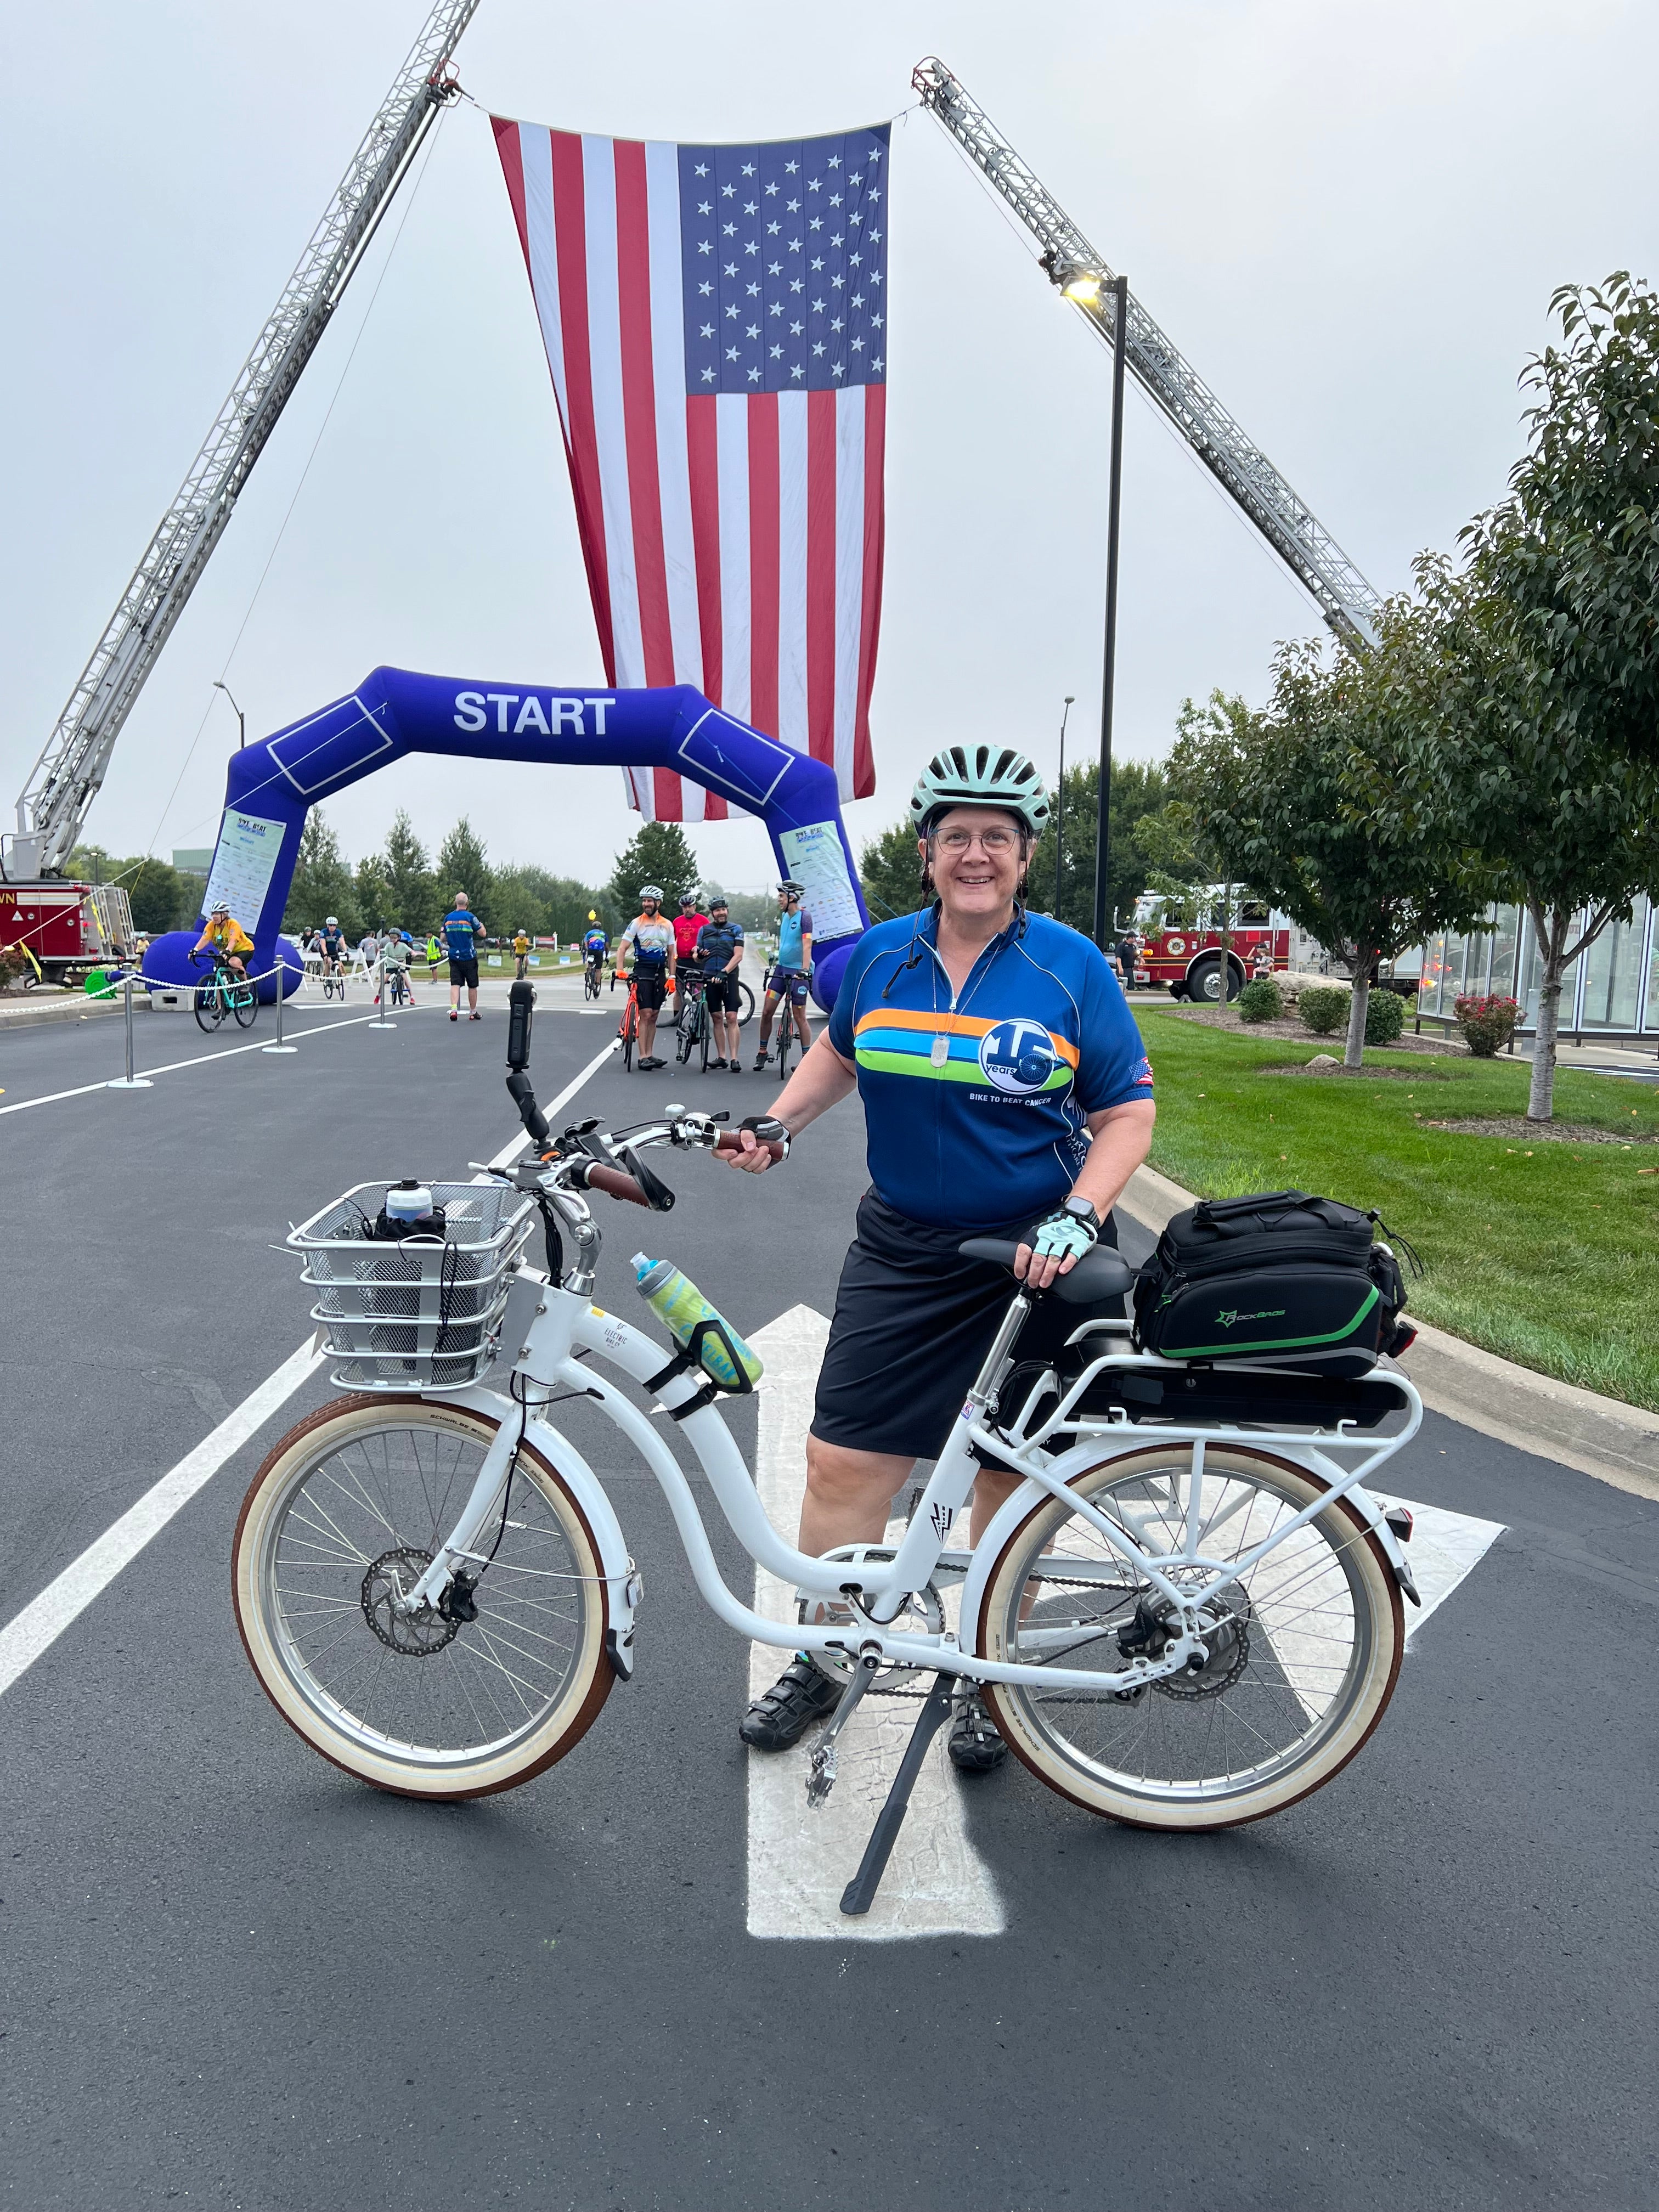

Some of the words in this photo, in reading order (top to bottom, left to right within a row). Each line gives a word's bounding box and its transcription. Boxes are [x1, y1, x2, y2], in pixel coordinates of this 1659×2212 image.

[453, 691, 616, 735] START
[986, 1064, 1015, 1075] years
[969, 1093, 988, 1102] BIKE
[1024, 1097, 1052, 1107] CANCER
[605, 1328, 628, 1344] ELECTRIC
[606, 1337, 615, 1345] BIKE
[430, 1414, 470, 1429] SCHWALBE
[1015, 1718, 1041, 1752] SCHWALBE
